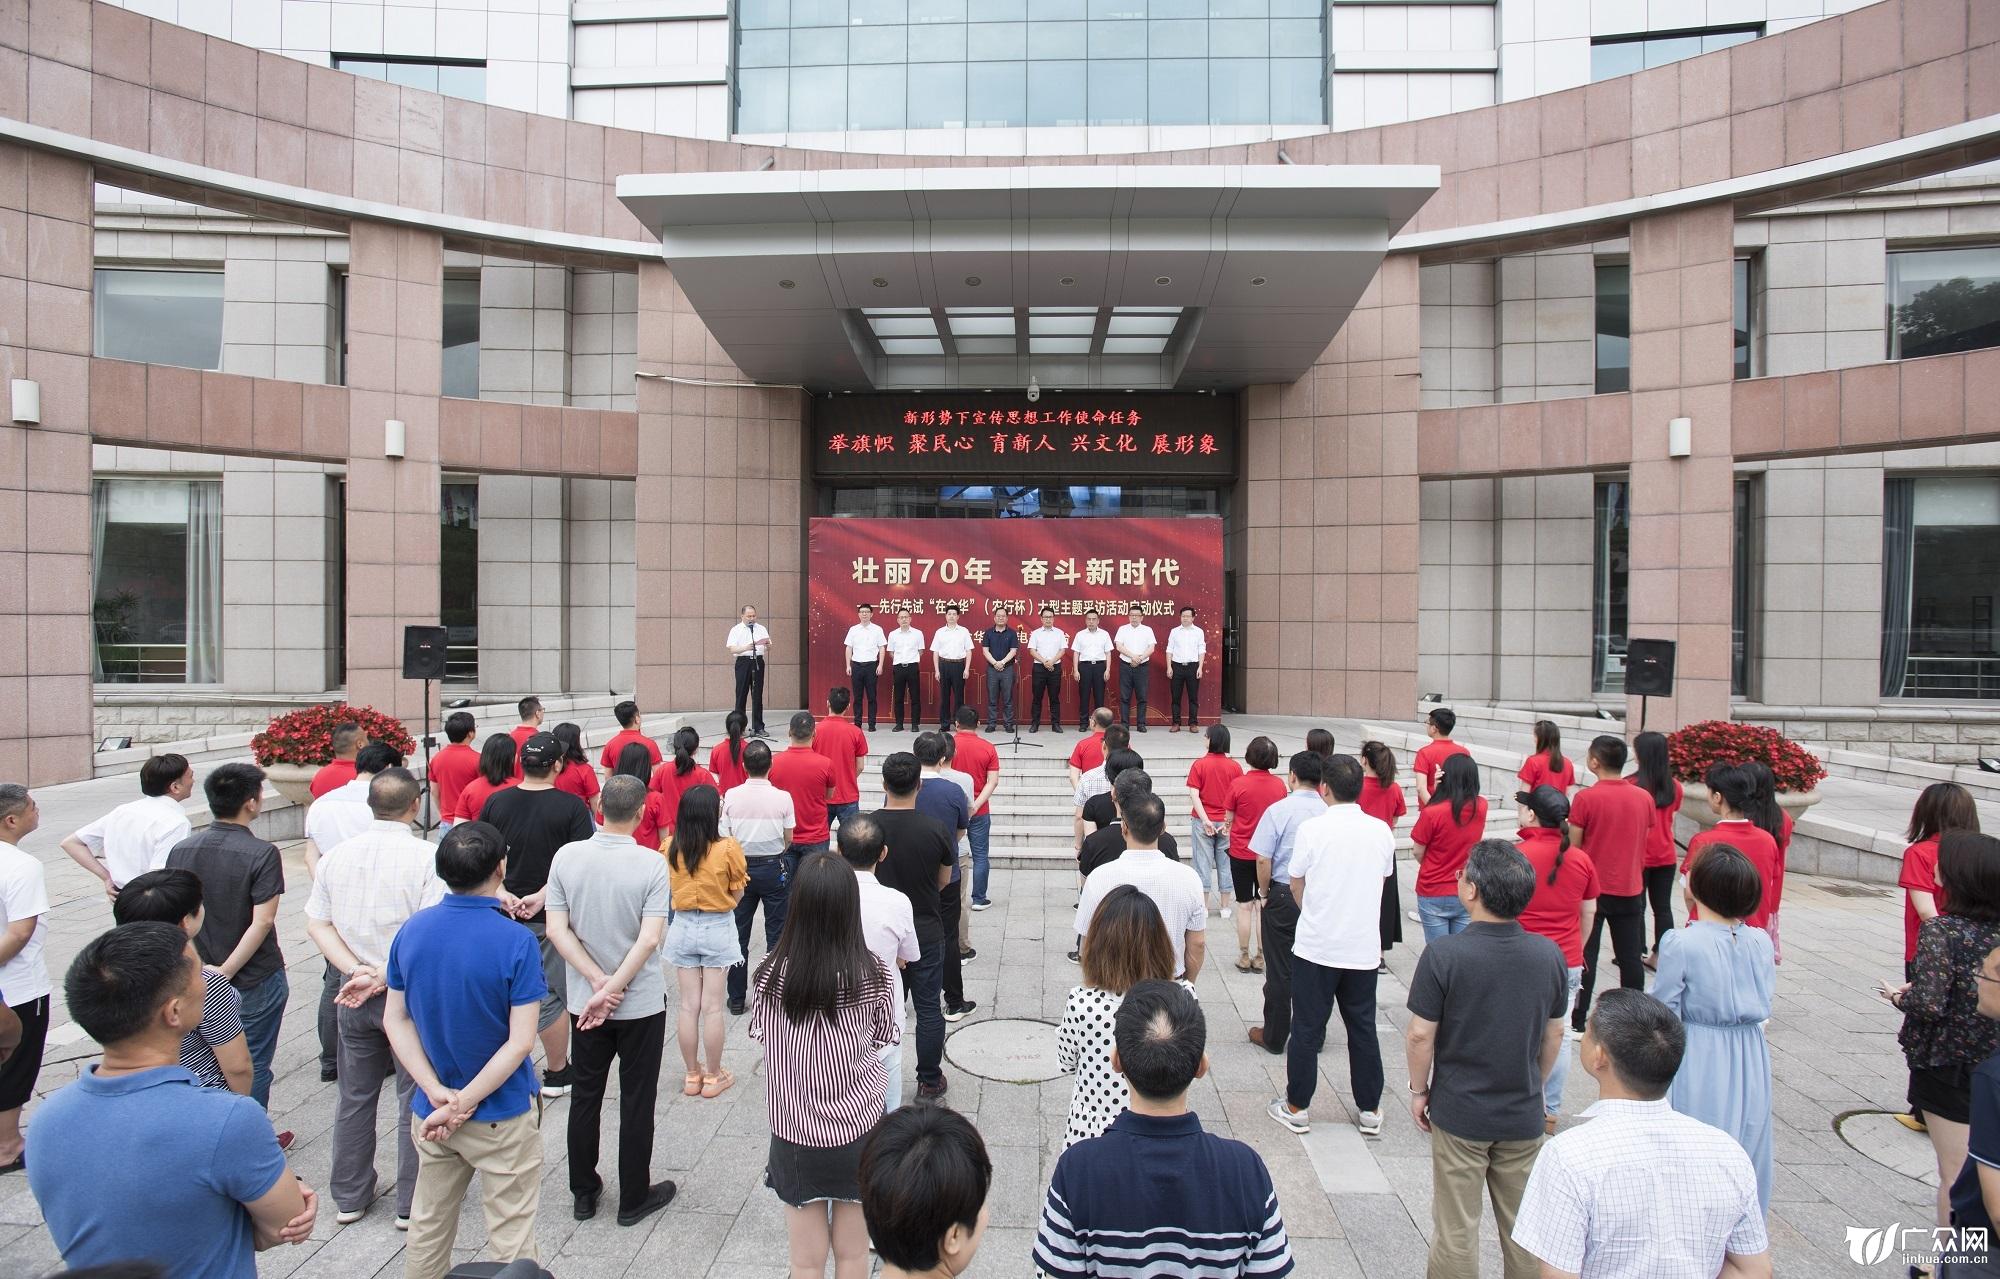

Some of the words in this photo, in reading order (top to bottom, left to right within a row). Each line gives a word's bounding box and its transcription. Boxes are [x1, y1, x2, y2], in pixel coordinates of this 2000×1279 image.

[903, 409, 1142, 427] 新形势下宣传思想工作使命任务
[828, 433, 896, 455] 举旗帜
[908, 433, 975, 454] 聚民心
[989, 432, 1056, 454] 育新人
[1070, 433, 1138, 453] 兴文化
[1151, 433, 1220, 455] 展形象
[852, 557, 992, 585] 壮丽70年
[1020, 557, 1180, 586] 奋斗新时代
